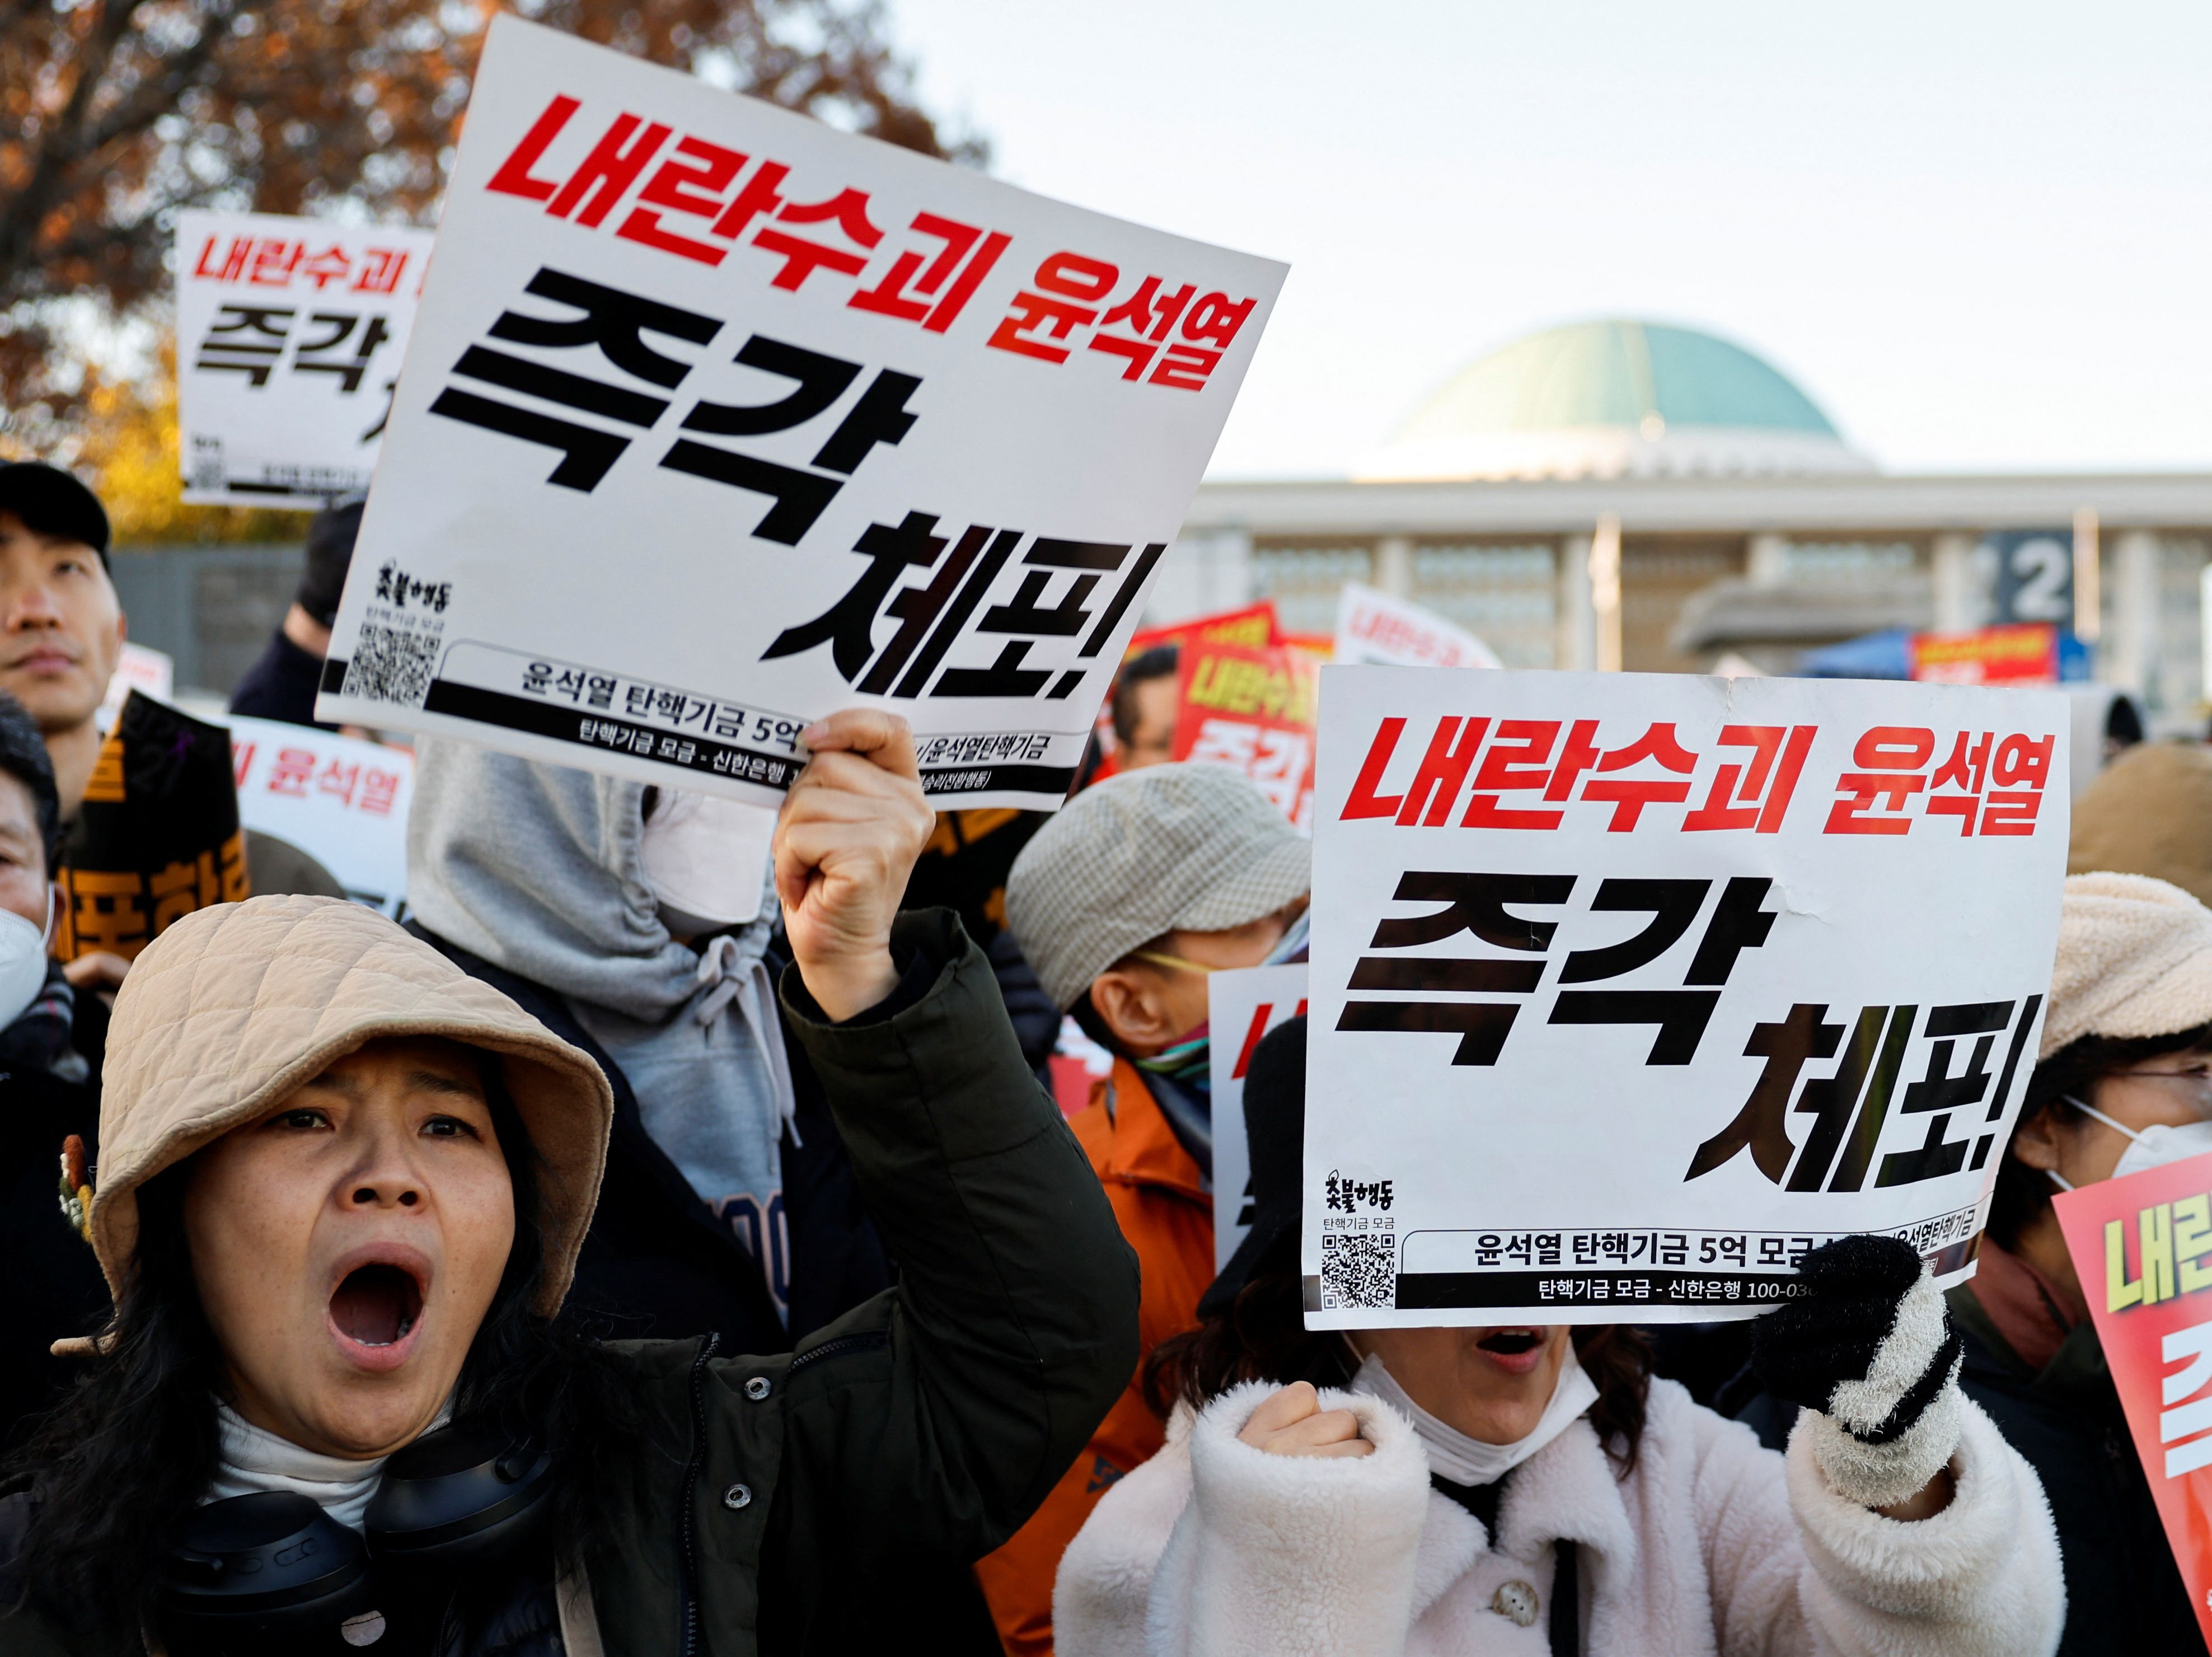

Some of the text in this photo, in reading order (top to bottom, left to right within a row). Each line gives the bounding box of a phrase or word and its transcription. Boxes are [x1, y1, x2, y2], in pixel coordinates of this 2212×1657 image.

[194, 235, 409, 296] 내란수괴
[485, 92, 1258, 392] 내란수괴 윤석열
[196, 303, 388, 393] 즉각
[428, 266, 924, 547] 즉각
[367, 606, 444, 633] 탄핵기금 모금
[758, 509, 1168, 700] 체포!
[523, 661, 804, 753] 윤석열 탄핵기금 5억
[268, 747, 400, 817] 윤석열
[580, 718, 654, 755] 탄핵기금
[658, 737, 696, 763] 모금
[713, 751, 786, 785] 신한은행
[916, 733, 1051, 765] /윤석열탄핵기금
[1339, 716, 1817, 834] 내란수괴
[1822, 726, 2055, 837] 윤석열
[1335, 871, 1779, 1066] 즉각
[1683, 993, 2043, 1192] 체포!
[1323, 1217, 1395, 1230] 탄핵기금 모금
[1325, 1173, 1394, 1214] 촛불행동
[1475, 1233, 1562, 1266] 윤석열
[1572, 1232, 1689, 1266] 탄핵기금
[1699, 1234, 1747, 1268] 5억
[1539, 1279, 1610, 1300] 탄핵기금
[1615, 1279, 1651, 1298] 모금
[1668, 1279, 1741, 1299] 신한은행
